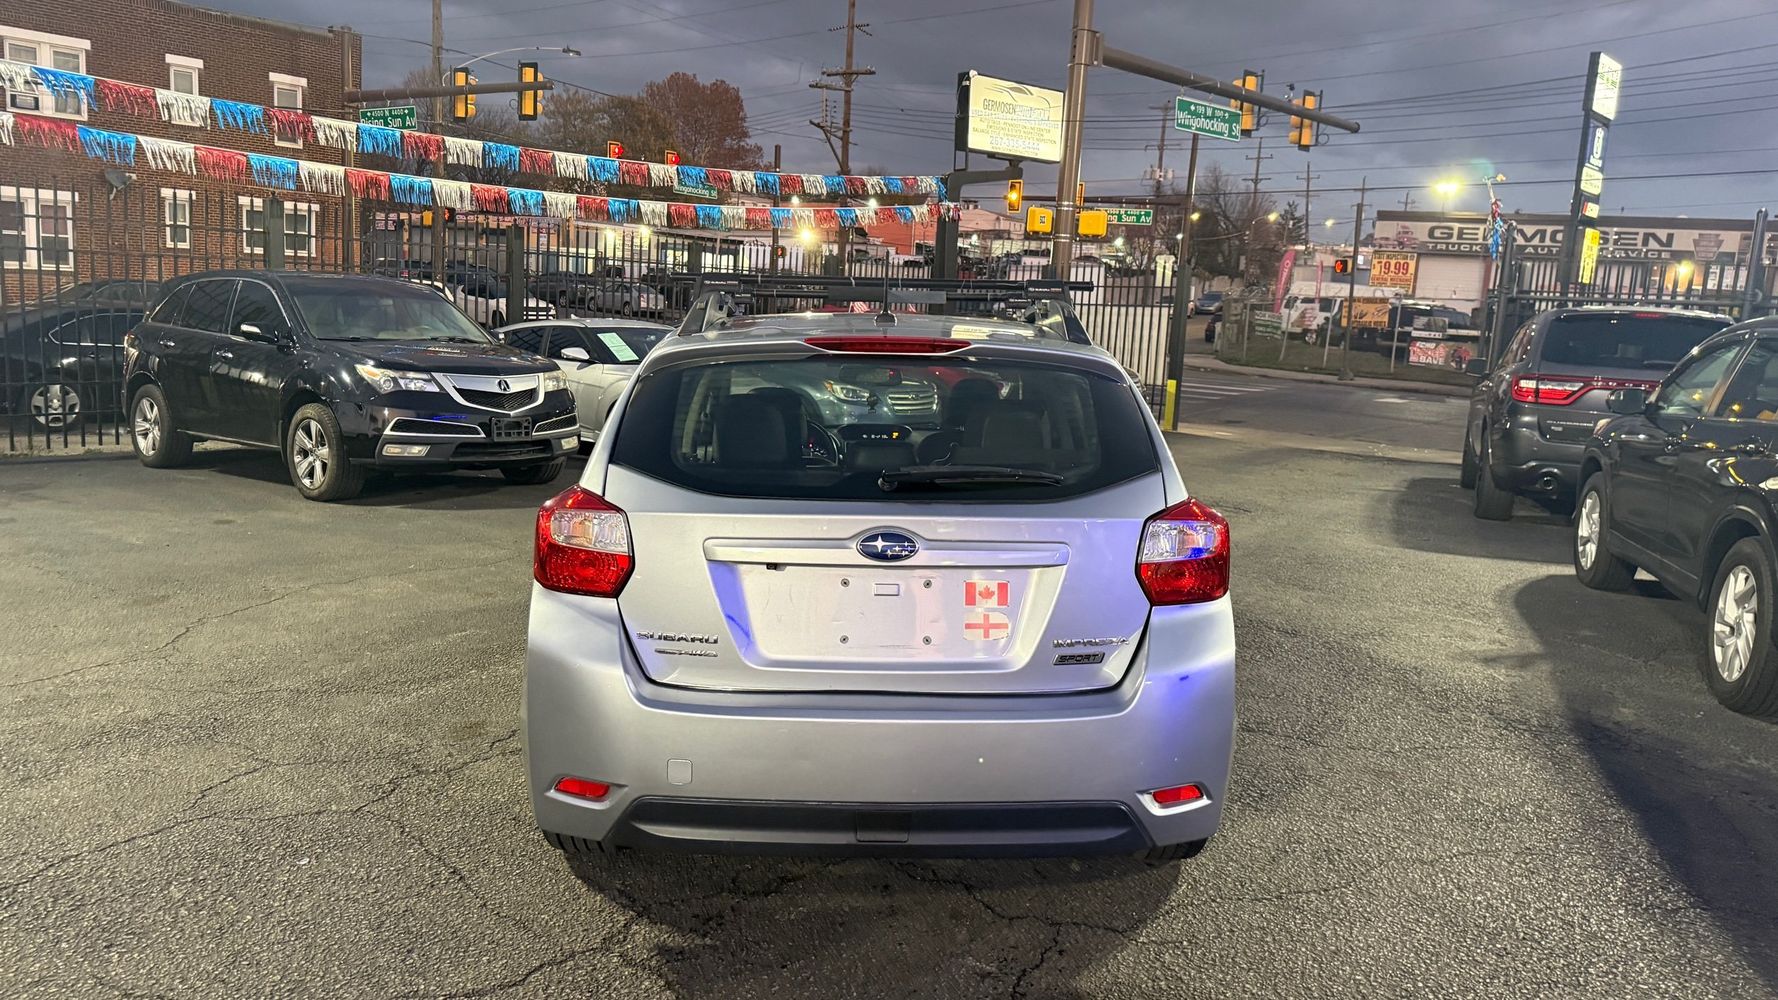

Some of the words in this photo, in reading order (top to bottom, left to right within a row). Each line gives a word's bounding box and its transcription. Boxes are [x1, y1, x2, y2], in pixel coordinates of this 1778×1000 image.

[385, 109, 390, 117] N
[1196, 106, 1205, 115] 199
[1206, 107, 1213, 117] W
[387, 117, 403, 128] Sun
[405, 116, 417, 127] Av
[1177, 111, 1229, 137] Wingohocking
[1231, 123, 1240, 136] St
[1121, 215, 1137, 223] Sun
[1140, 215, 1151, 223] Av
[1427, 242, 1482, 252] TRUCK
[1524, 246, 1561, 254] AUT
[1602, 249, 1671, 259] ERVICE
[636, 631, 719, 644] SUBARU
[1053, 636, 1130, 648] IMPREZA
[1057, 653, 1101, 663] SPORT
